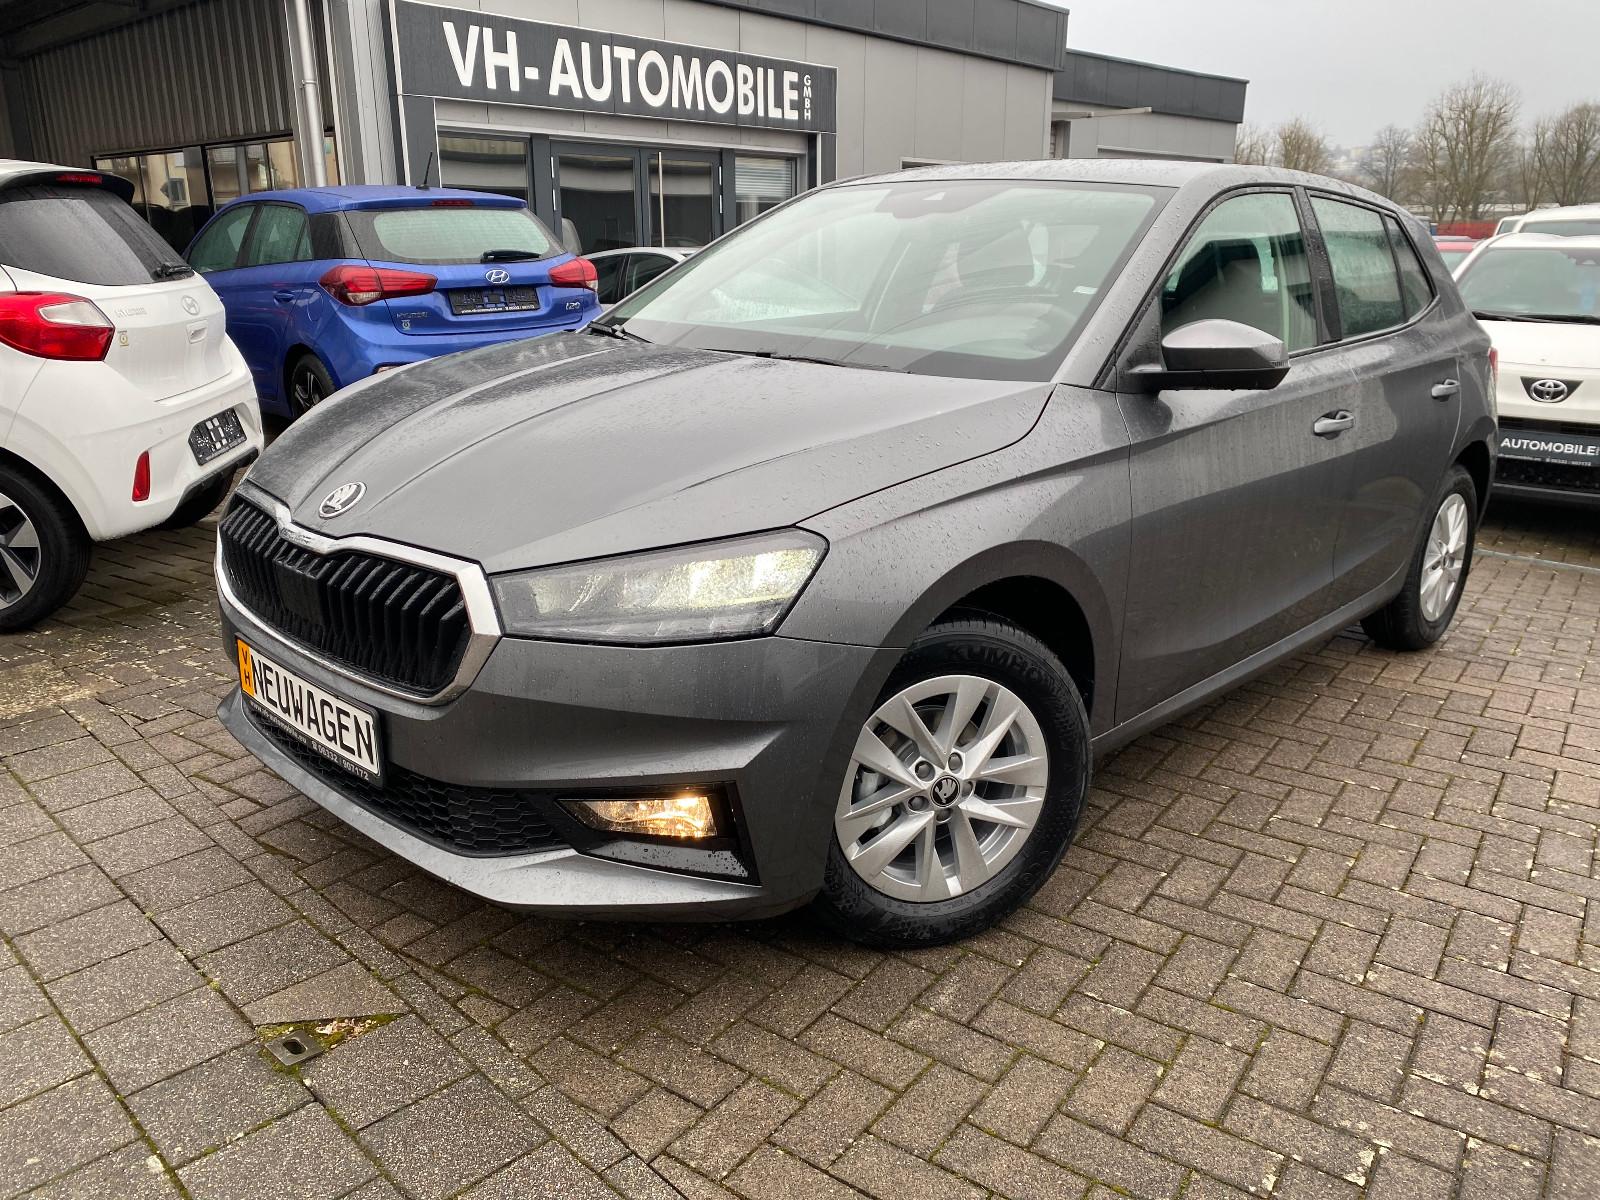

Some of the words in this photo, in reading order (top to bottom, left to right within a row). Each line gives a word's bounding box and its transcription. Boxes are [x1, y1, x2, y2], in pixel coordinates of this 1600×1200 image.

[548, 38, 799, 120] AUTOMOBILE
[803, 74, 812, 121] GMBH
[1500, 437, 1595, 456] AUTOMOBILE
[250, 654, 374, 766] NEUWAGEN
[342, 759, 369, 781] 907172
